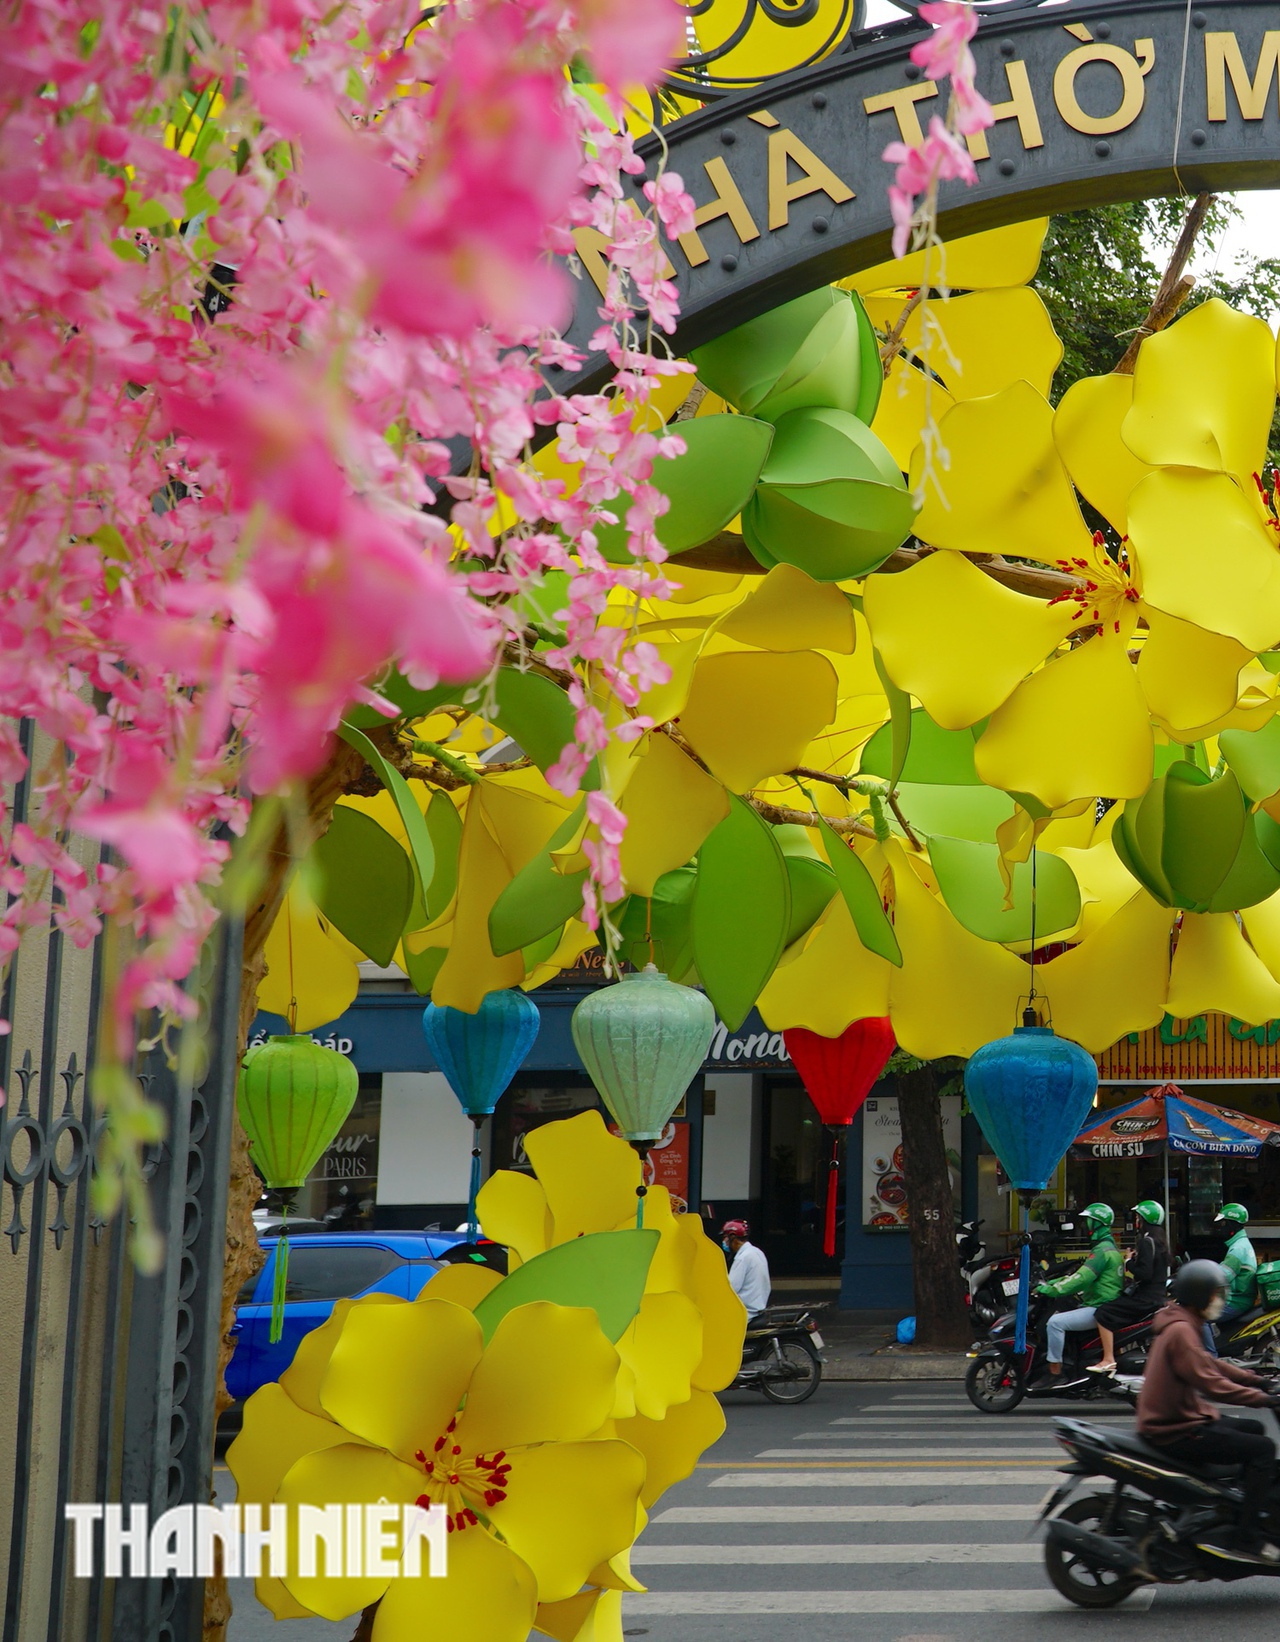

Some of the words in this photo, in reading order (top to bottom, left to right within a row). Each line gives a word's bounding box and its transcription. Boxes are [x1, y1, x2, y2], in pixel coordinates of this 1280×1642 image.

[863, 22, 1156, 162] THỜ
[1092, 1142, 1144, 1158] CHIN-SU
[323, 1157, 367, 1178] PARIS
[924, 1209, 939, 1220] 55
